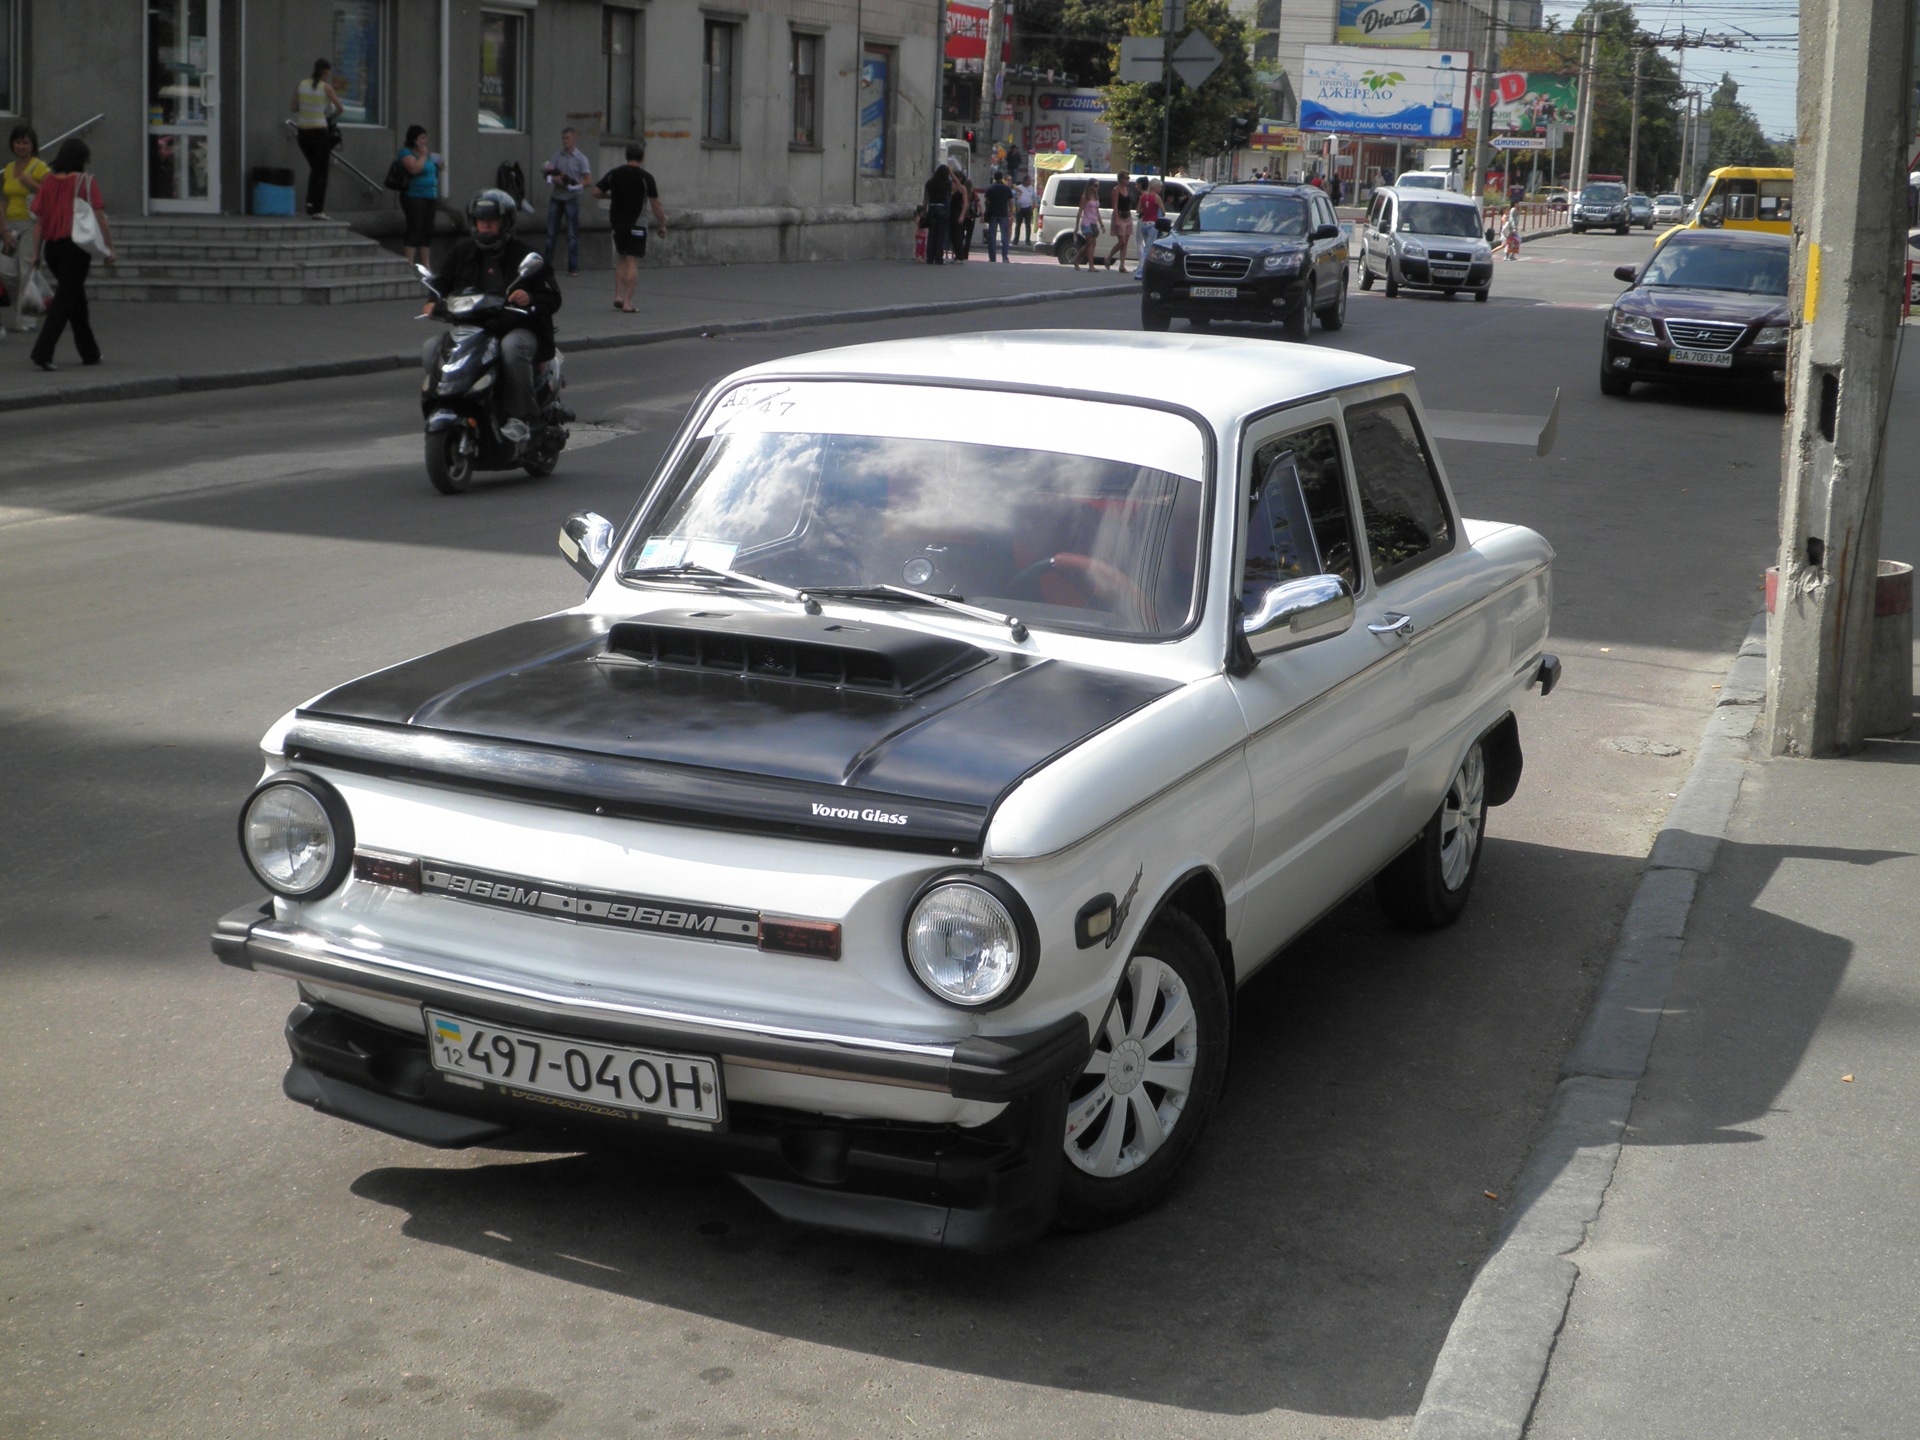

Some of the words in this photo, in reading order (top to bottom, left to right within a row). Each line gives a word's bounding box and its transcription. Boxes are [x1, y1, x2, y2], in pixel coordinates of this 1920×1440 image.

[1317, 87, 1393, 100] ДЖЕРЕЛО
[1315, 119, 1354, 128] СПРАВЖНІЙ
[1355, 121, 1375, 129] СМАК
[1376, 121, 1402, 131] ЧИСТОЇ
[1403, 123, 1422, 132] ВОДИ
[1494, 138, 1530, 146] ДЖИНСИ
[1676, 350, 1689, 361] BA
[1691, 352, 1713, 363] 7003
[1715, 354, 1730, 364] AM
[812, 802, 859, 820] Voron
[861, 808, 908, 825] Glass
[448, 875, 539, 906] 968M
[608, 903, 715, 932] 968M
[442, 1045, 465, 1068] 12
